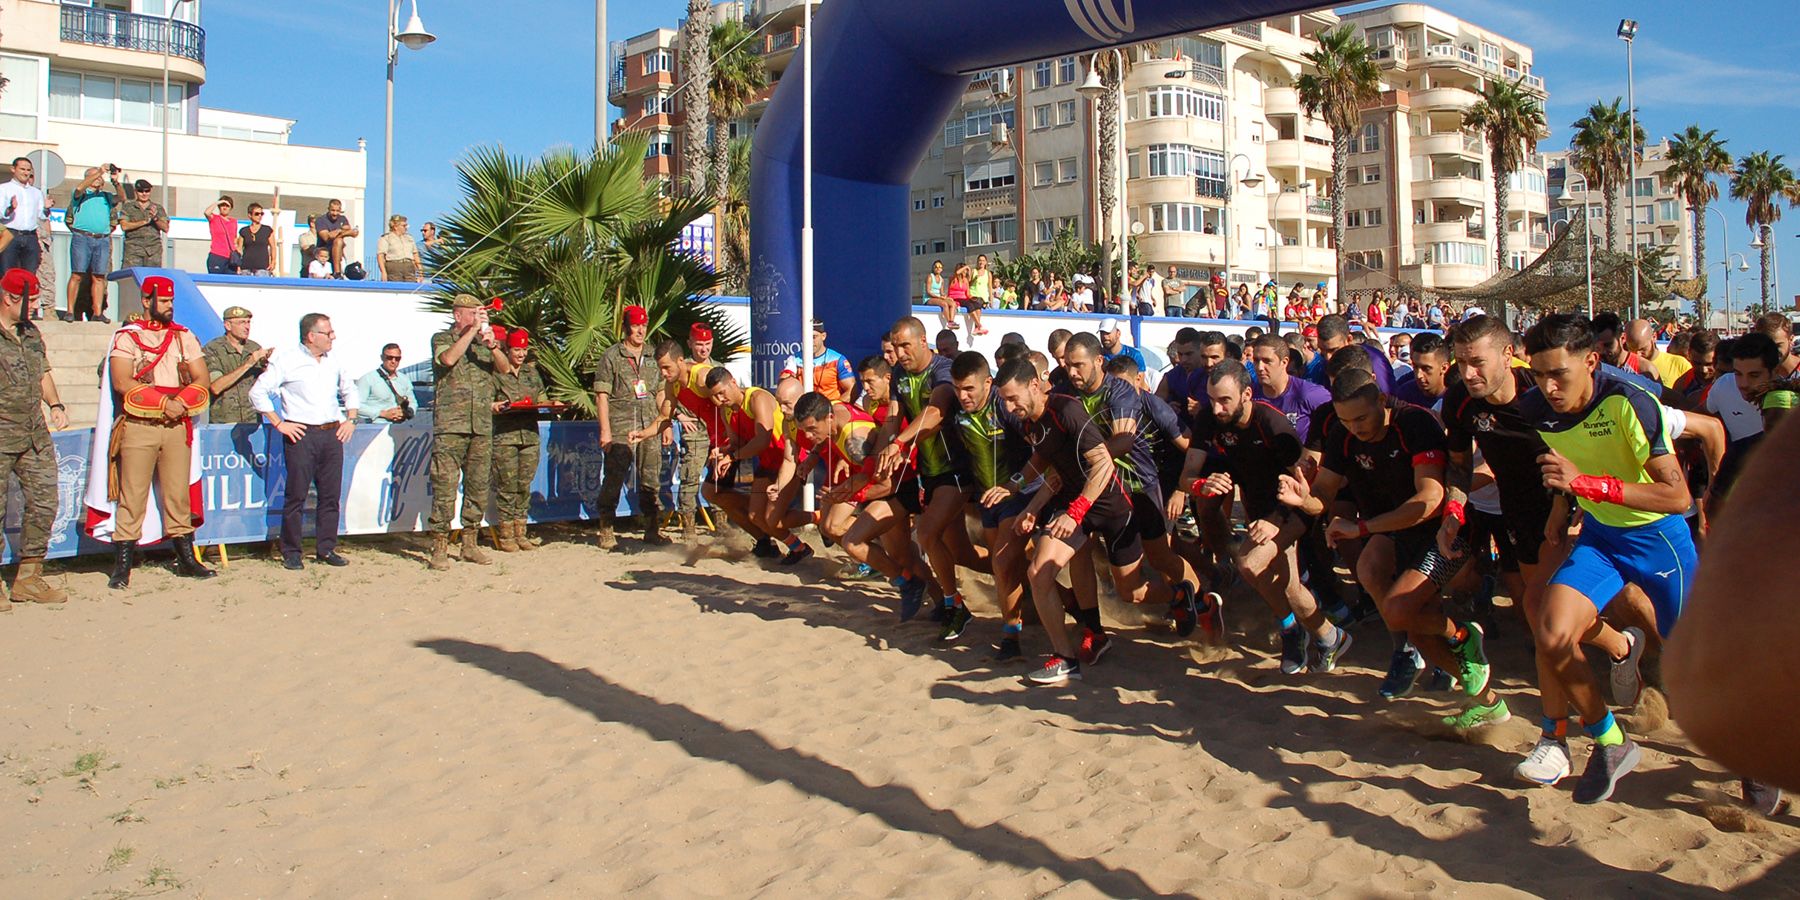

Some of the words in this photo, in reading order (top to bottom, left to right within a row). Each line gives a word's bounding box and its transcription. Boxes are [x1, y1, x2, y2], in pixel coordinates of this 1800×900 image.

[1582, 420, 1616, 429] Runner's
[200, 450, 285, 470] UTÓNOM
[206, 473, 285, 512] ILLA
